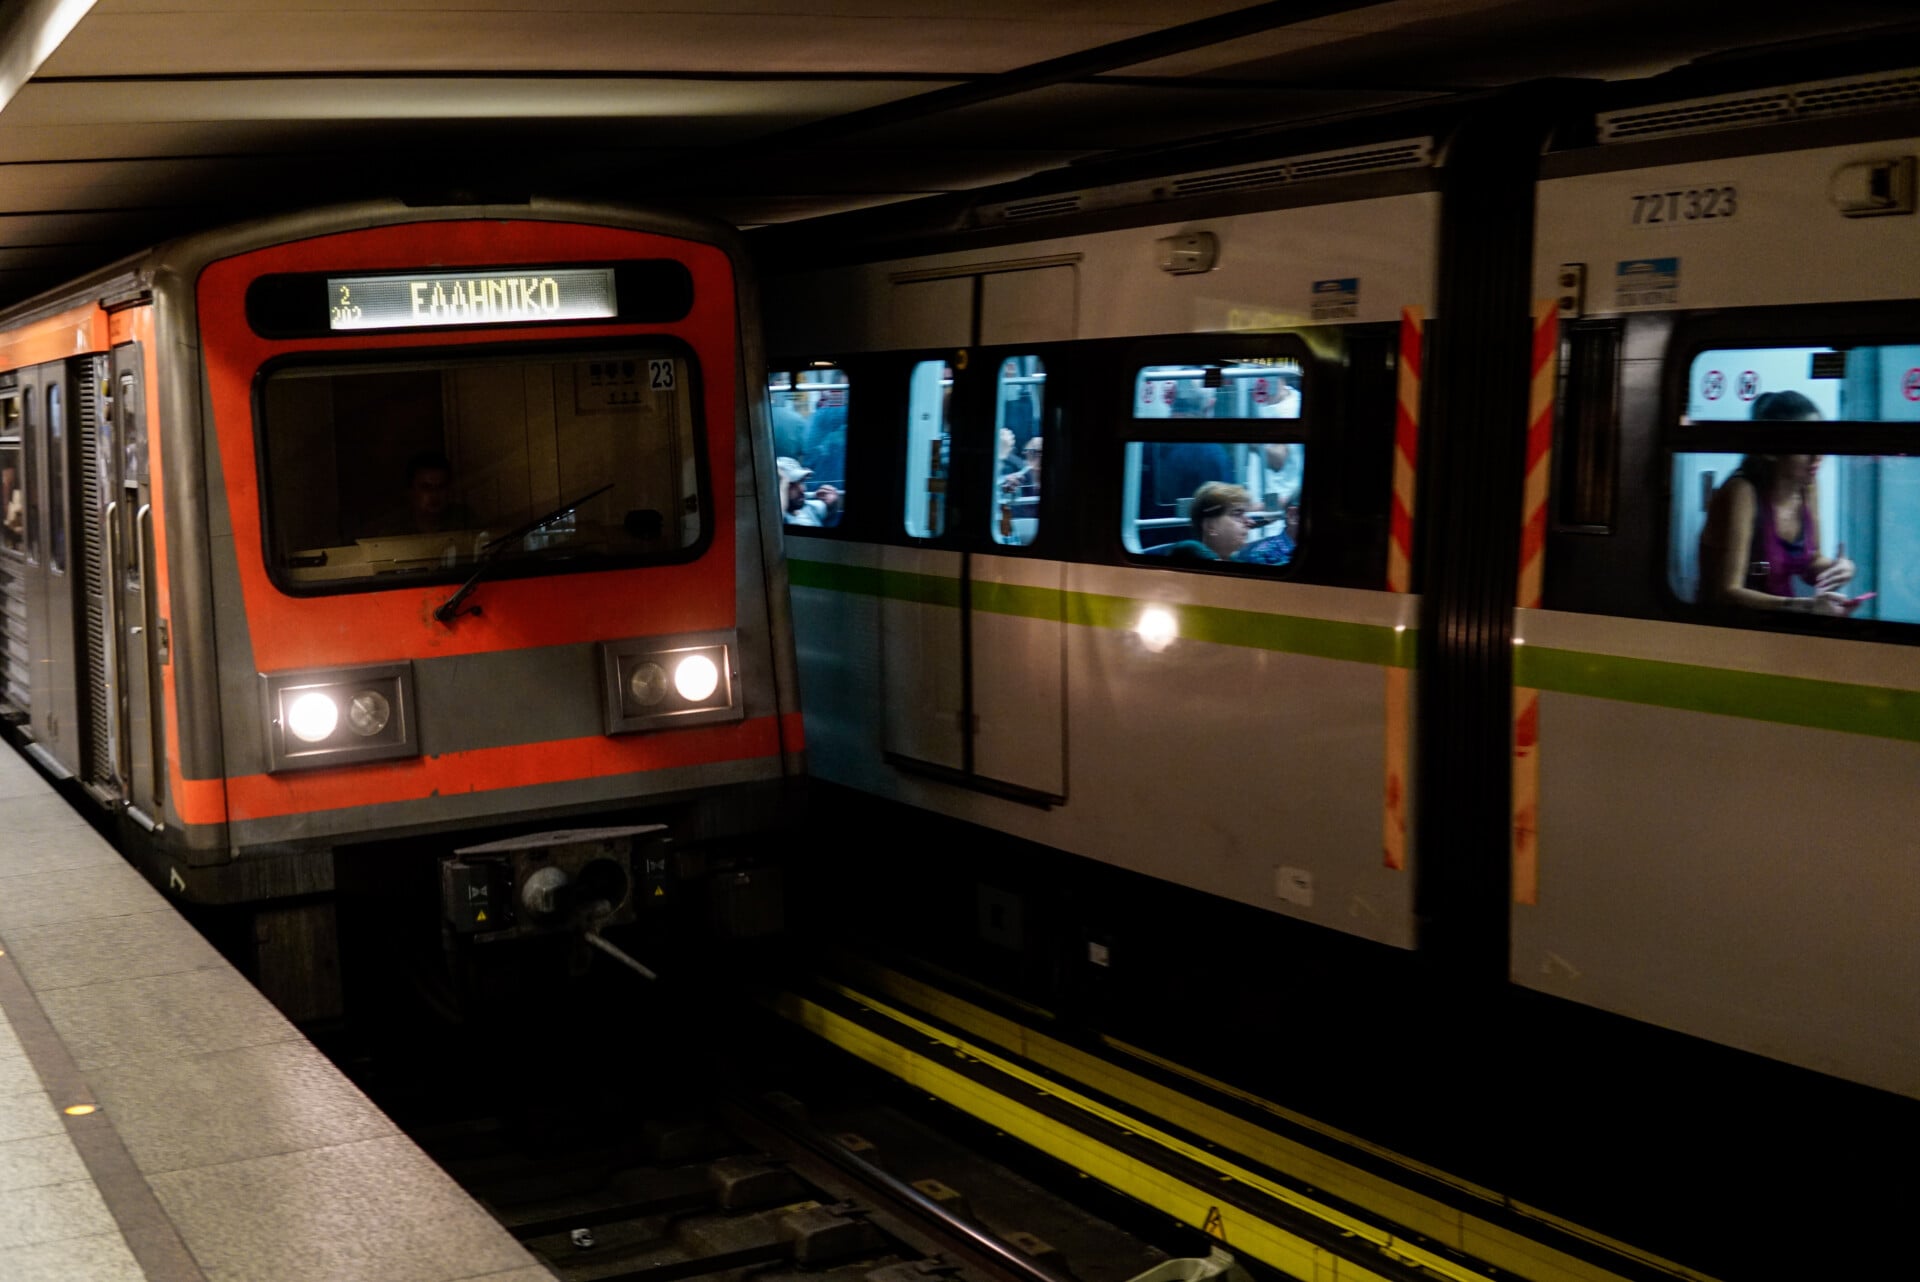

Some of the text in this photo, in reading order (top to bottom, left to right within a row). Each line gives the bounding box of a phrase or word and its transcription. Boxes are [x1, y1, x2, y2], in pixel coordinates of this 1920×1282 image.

[1631, 186, 1737, 224] 72T323
[340, 286, 351, 305] 2
[651, 362, 673, 388] 23
